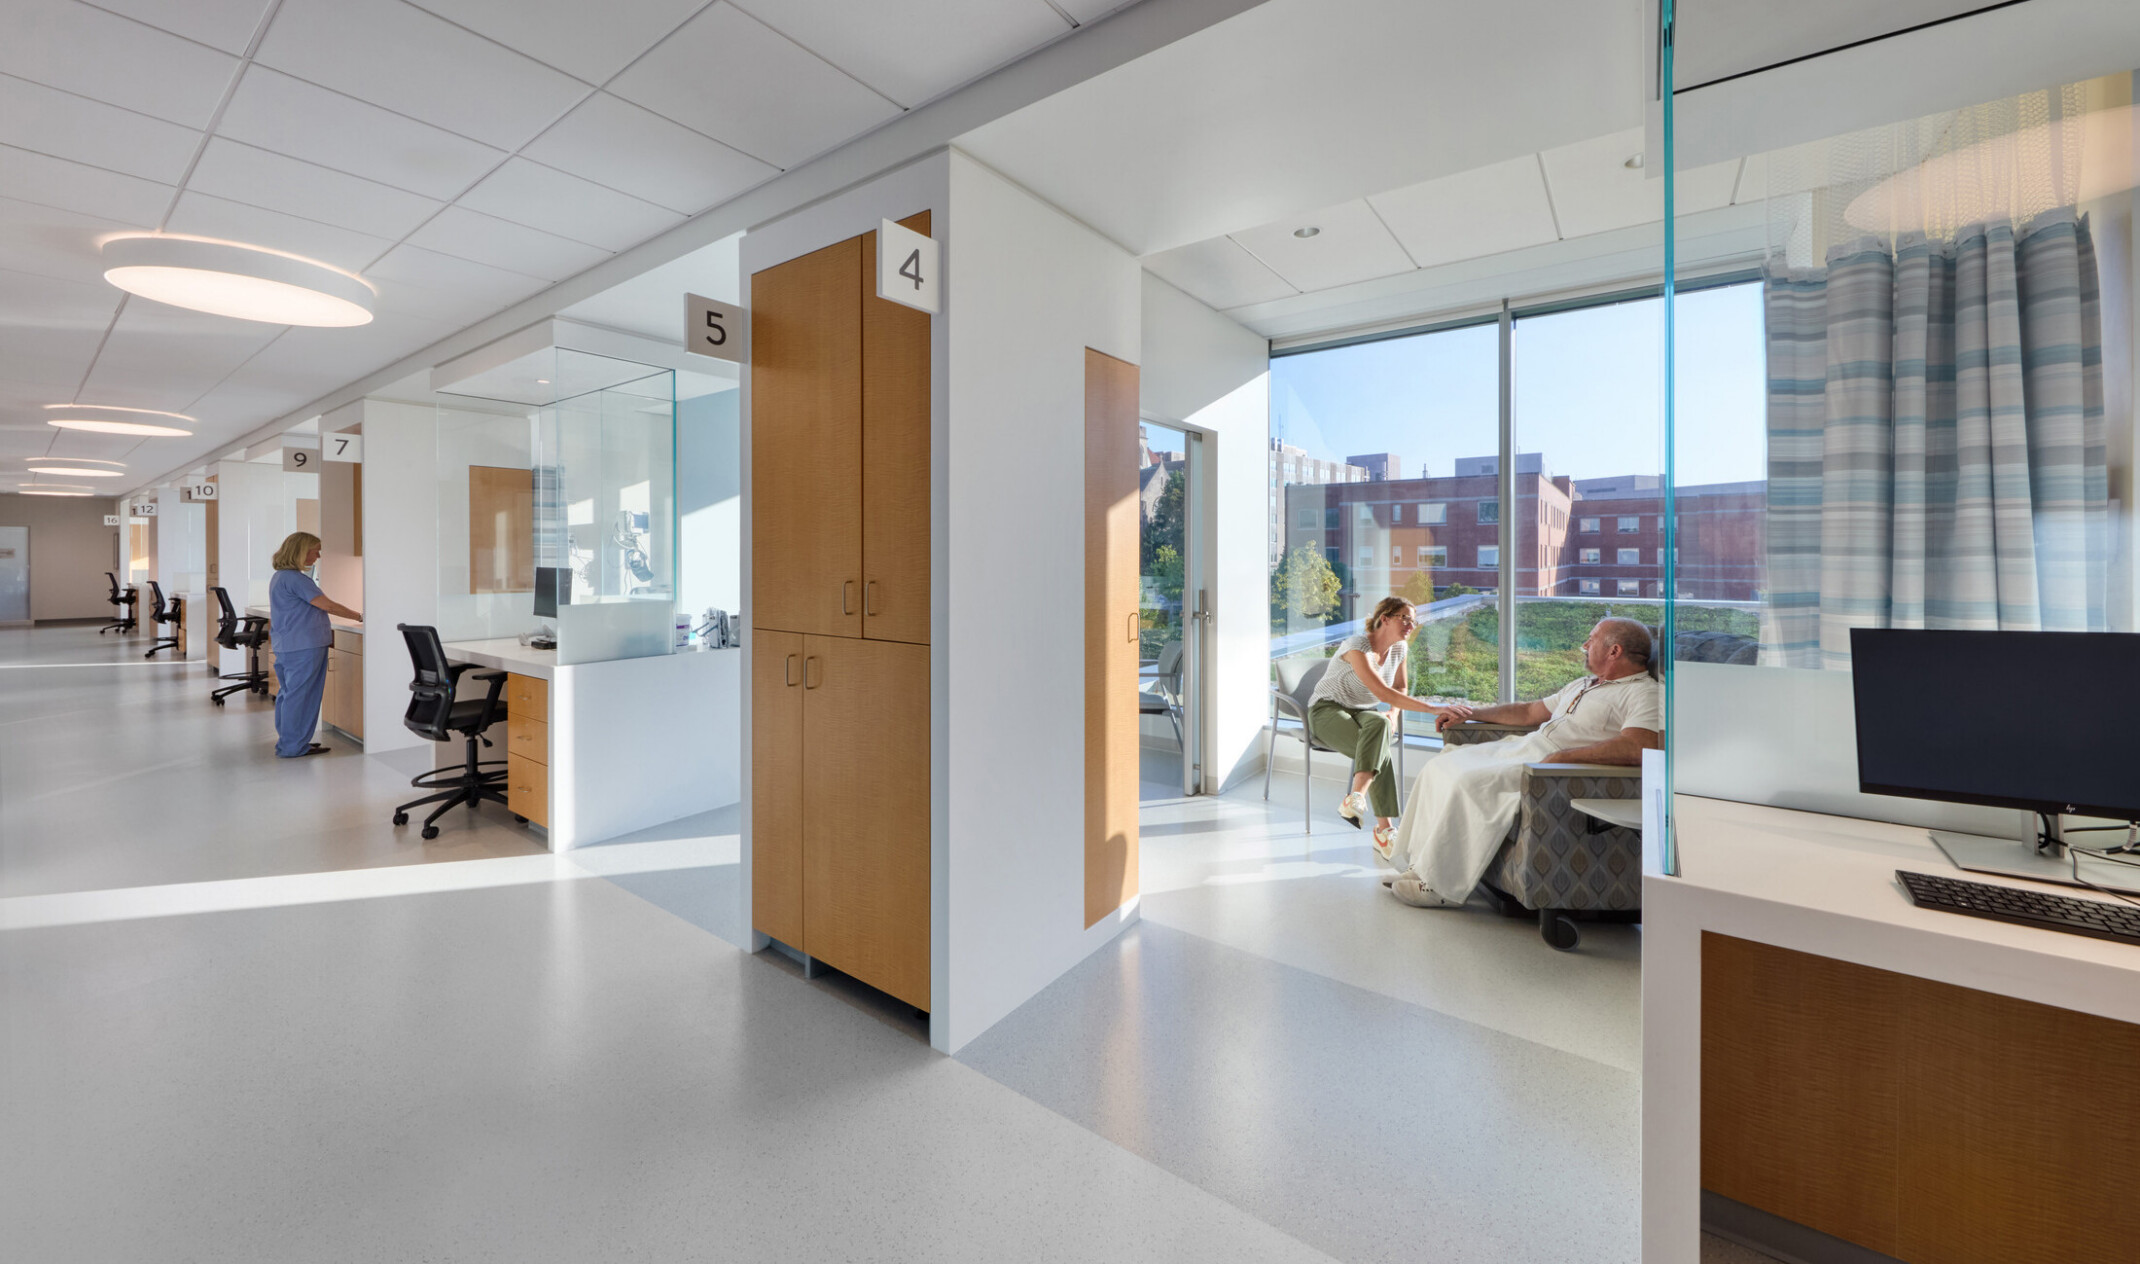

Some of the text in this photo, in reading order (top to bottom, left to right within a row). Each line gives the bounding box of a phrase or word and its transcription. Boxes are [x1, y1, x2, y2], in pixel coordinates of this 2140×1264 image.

[899, 248, 924, 290] 4
[706, 310, 727, 346] 5
[335, 438, 349, 456] 7
[293, 452, 307, 468] 9
[196, 485, 214, 496] 10
[141, 505, 154, 514] 12
